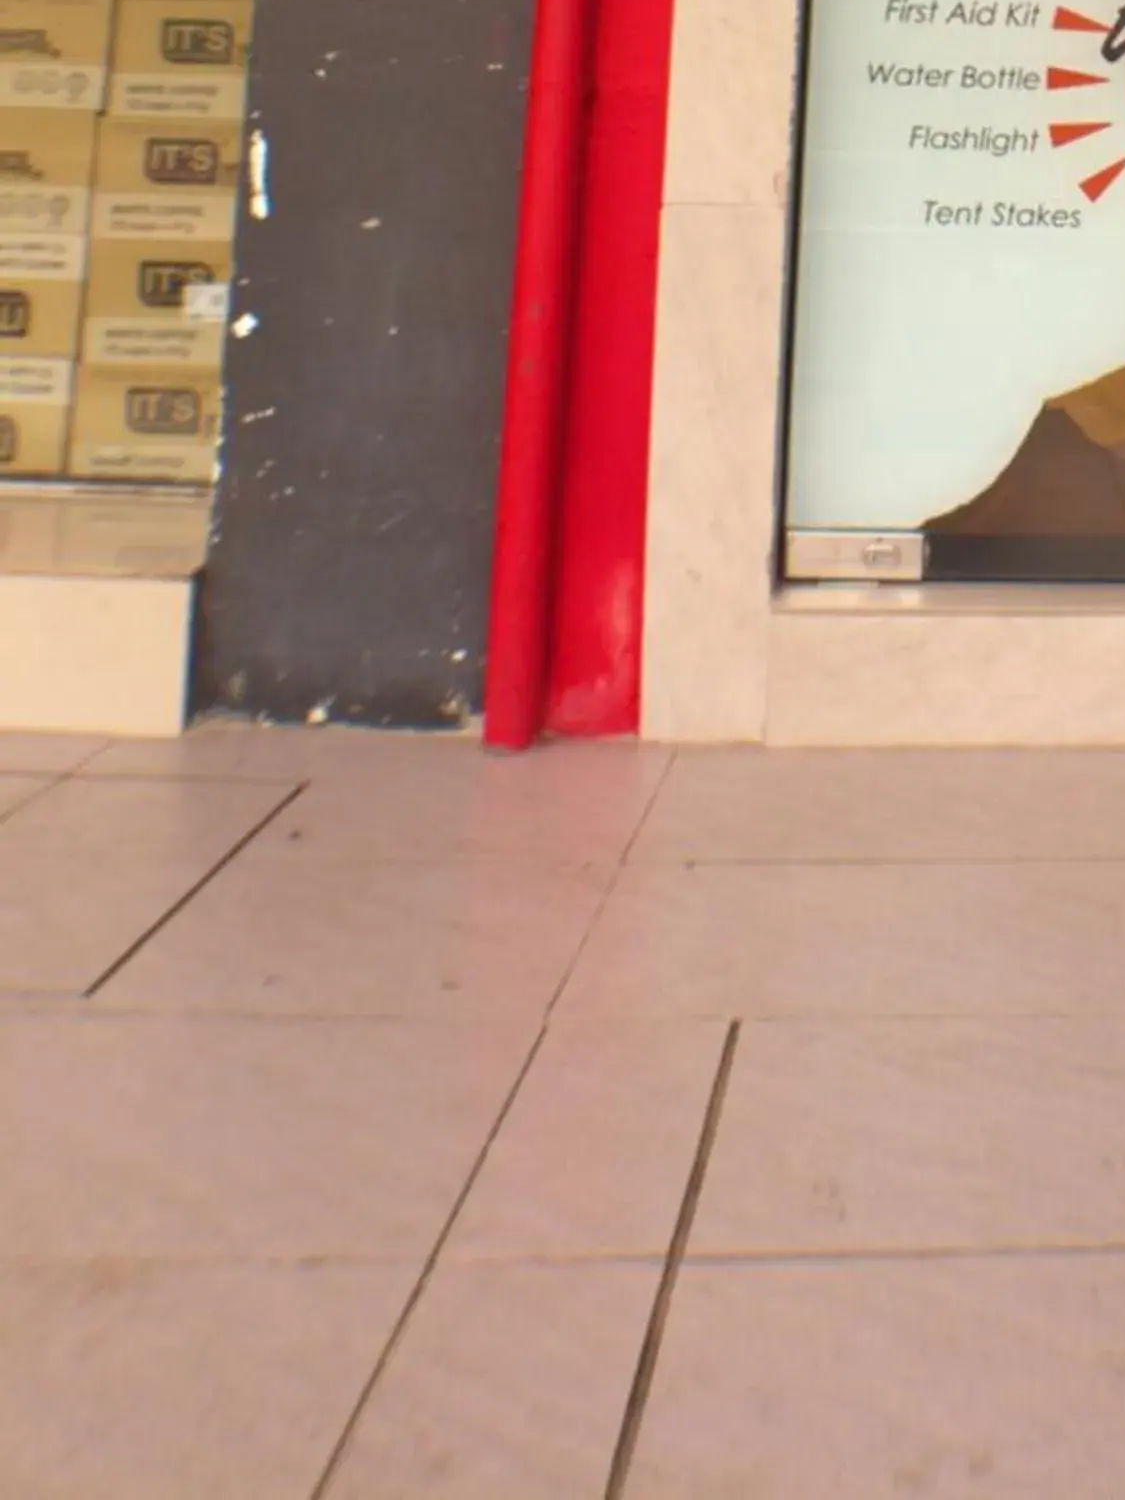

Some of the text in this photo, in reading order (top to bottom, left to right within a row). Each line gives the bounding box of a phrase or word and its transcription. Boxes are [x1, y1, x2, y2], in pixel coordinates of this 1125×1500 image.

[945, 0, 998, 27] Aid
[1004, 0, 1041, 28] Kit
[867, 60, 1041, 91] Water Bottle
[908, 124, 1040, 157] Flashlight
[924, 199, 1083, 229] Tent Stakes
